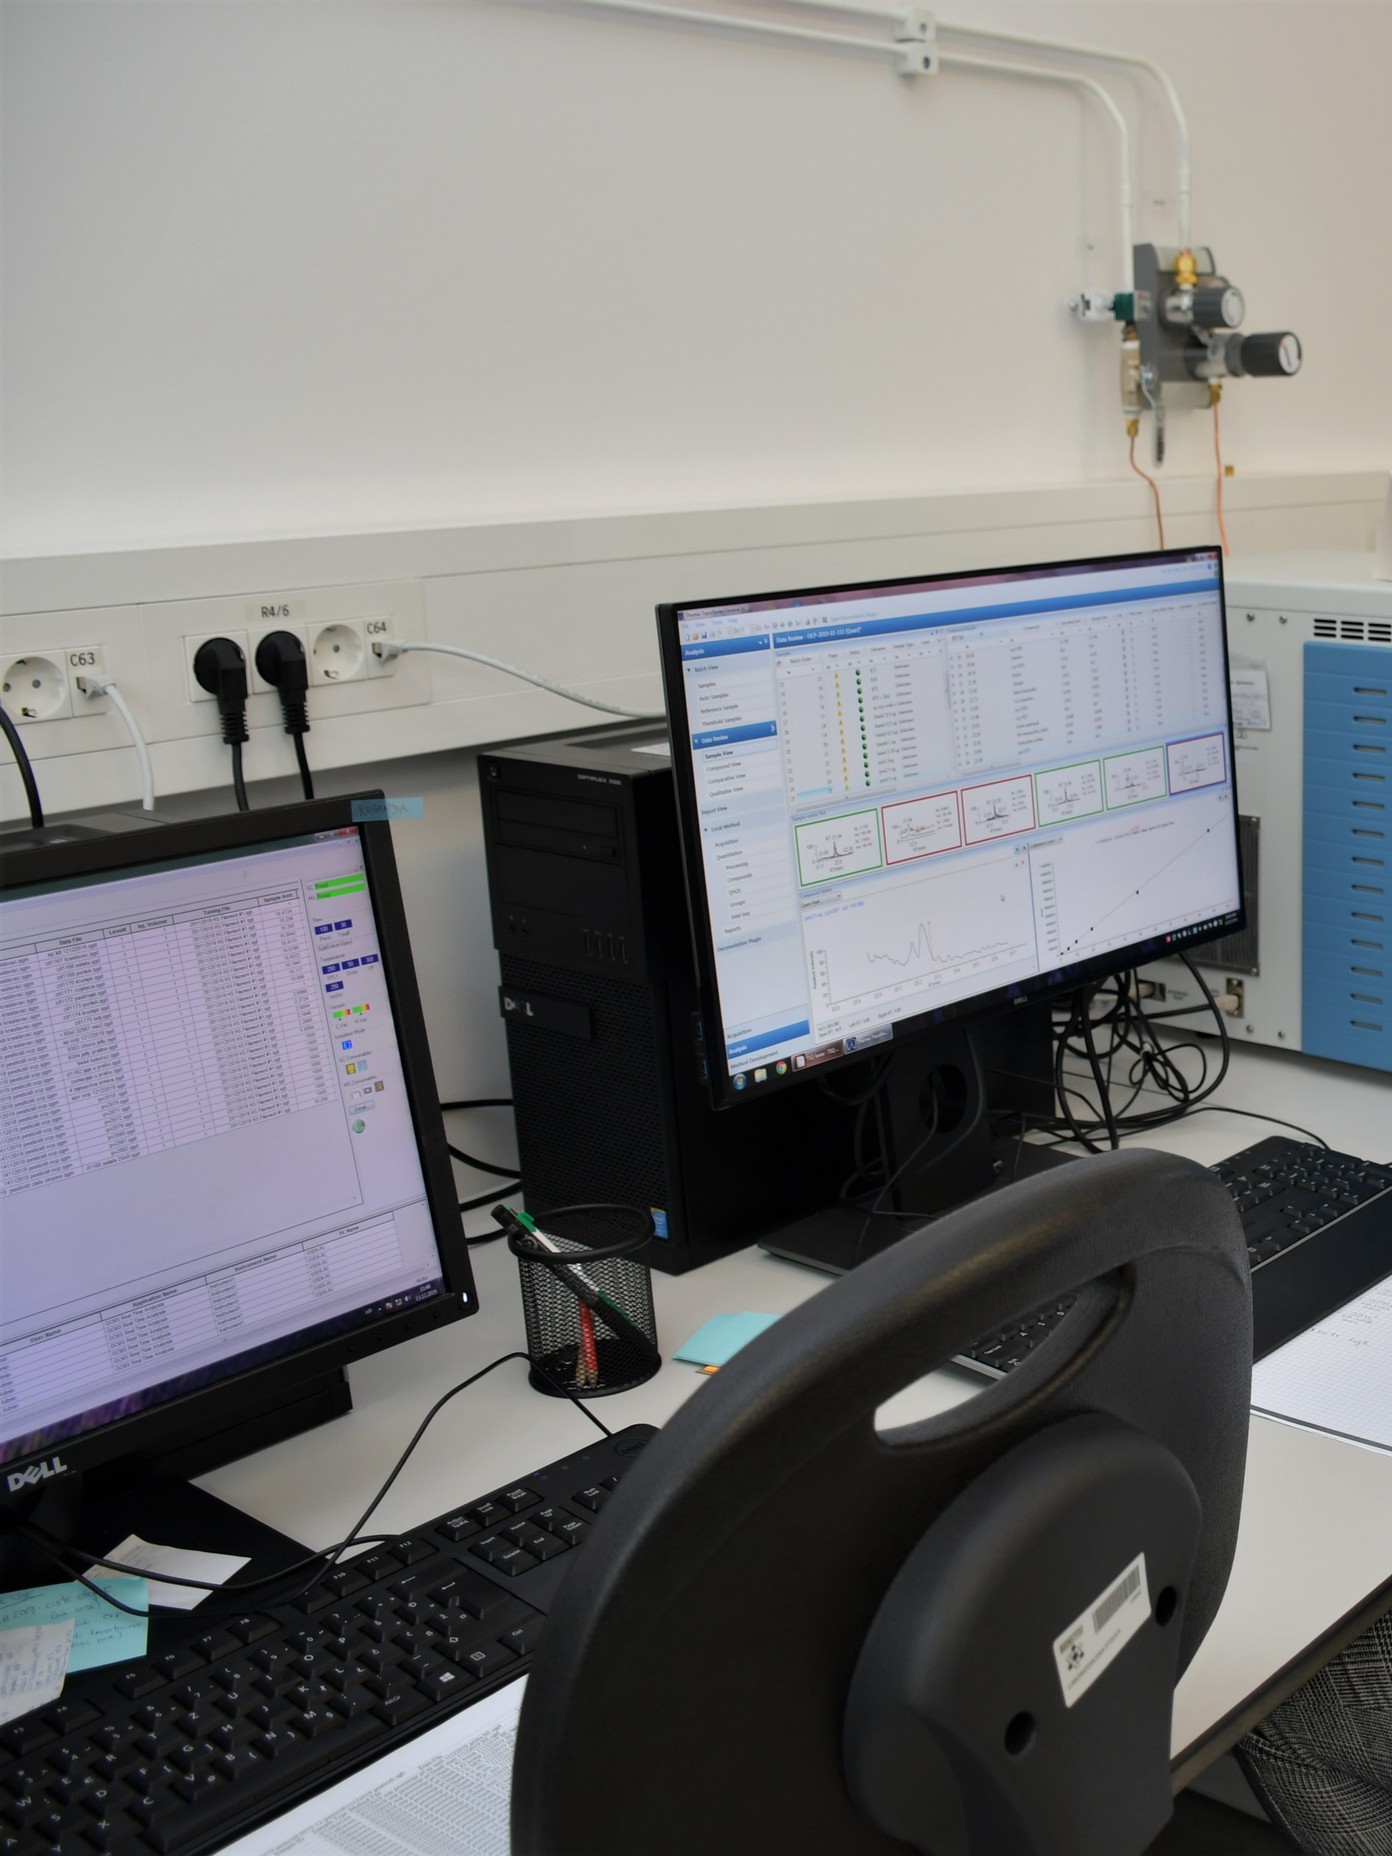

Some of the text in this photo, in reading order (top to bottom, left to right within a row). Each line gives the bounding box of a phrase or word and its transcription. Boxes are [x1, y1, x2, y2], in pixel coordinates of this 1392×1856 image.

[260, 604, 290, 619] R4/6
[366, 621, 388, 634] C64
[684, 648, 705, 657] Analysis
[69, 651, 96, 667] C63
[700, 704, 739, 714] Reference Sample
[701, 734, 729, 745] Data Review
[705, 752, 722, 760] Sample
[706, 764, 730, 773] Compound
[708, 776, 735, 785] Comparative
[709, 788, 733, 798] Qualitative
[701, 806, 716, 815] Report
[723, 821, 741, 830] Method
[715, 839, 739, 848] Acquisition
[716, 850, 743, 861] Quantitation
[726, 861, 749, 870] Processing
[727, 873, 753, 883] Compounds
[730, 900, 746, 908] Groups
[724, 926, 742, 934] Reports
[728, 1043, 748, 1054] Analysis
[730, 1050, 779, 1069] Method Development
[132, 1288, 178, 1308] Application Name
[30, 1329, 62, 1343] User Name
[7, 1456, 68, 1492] DELL
